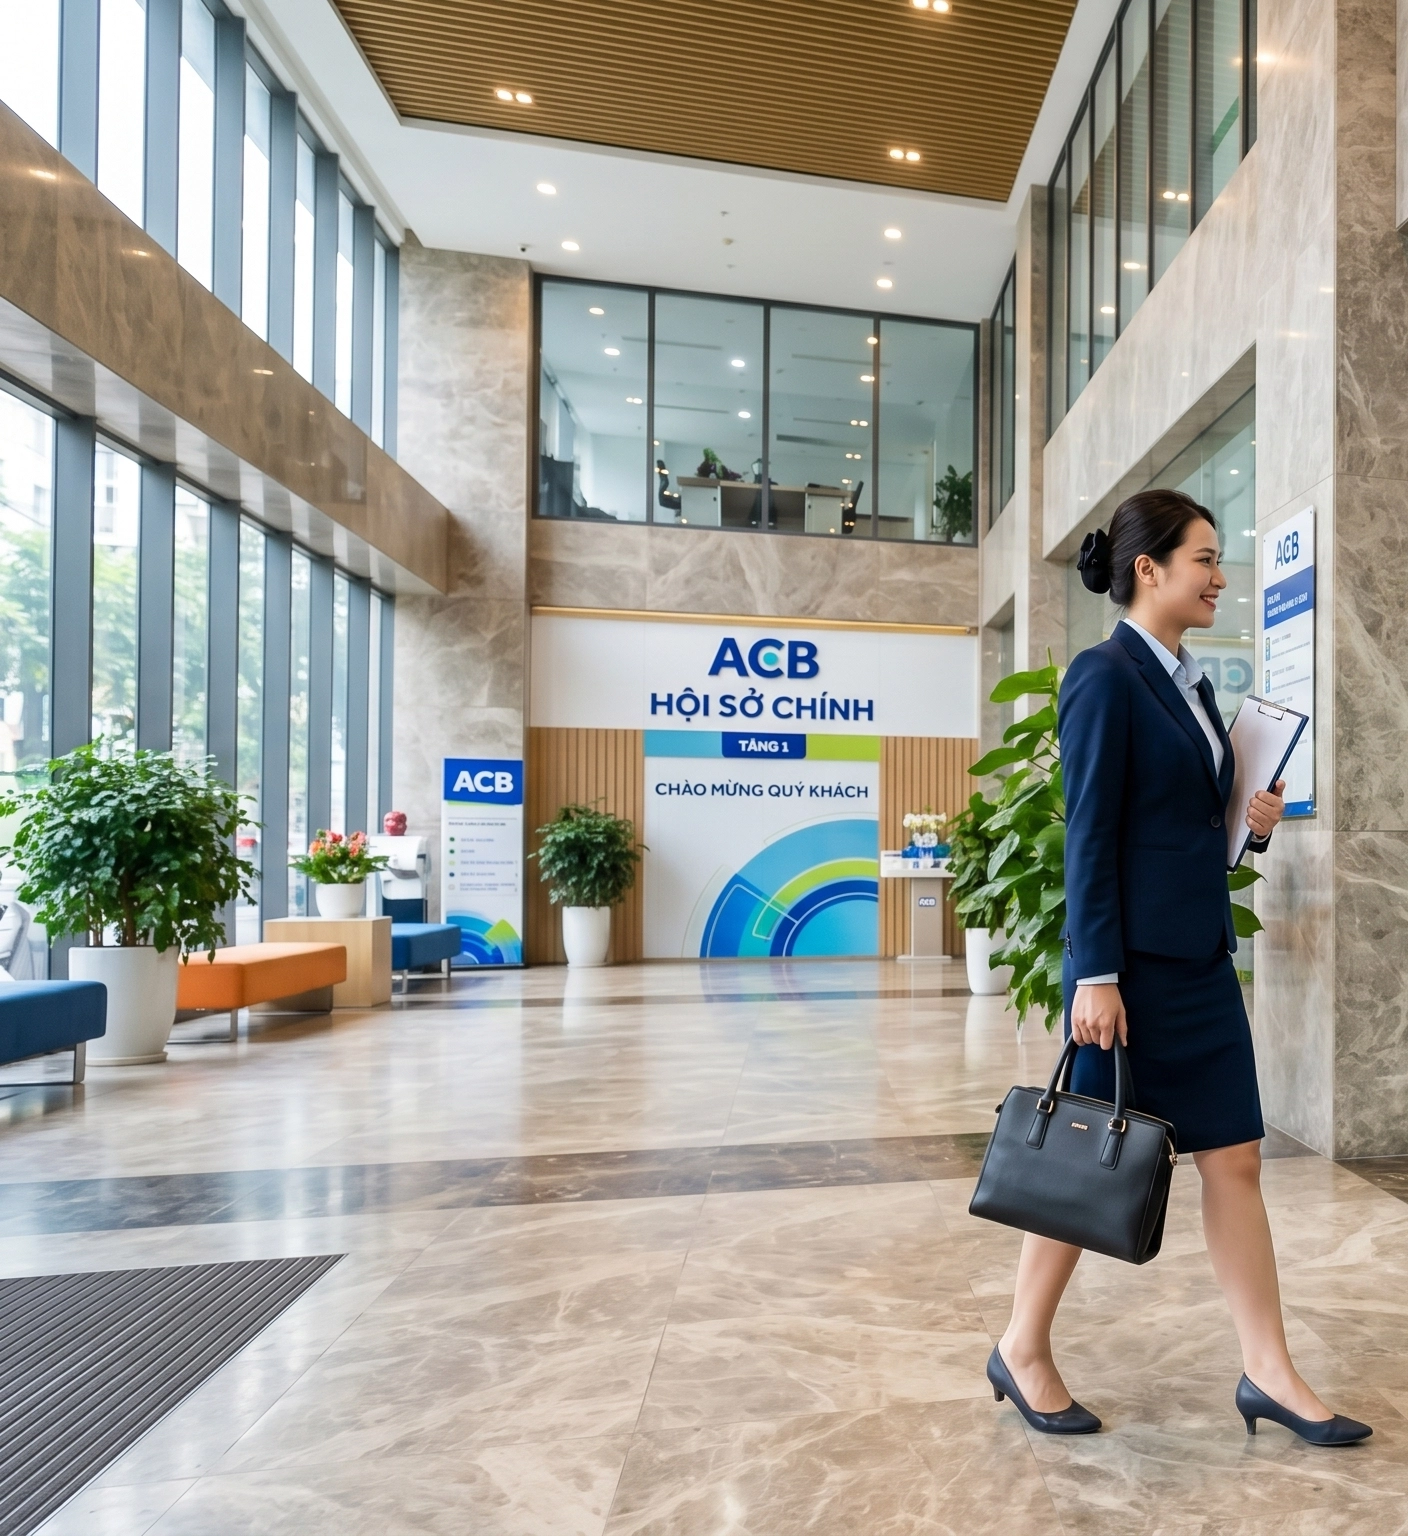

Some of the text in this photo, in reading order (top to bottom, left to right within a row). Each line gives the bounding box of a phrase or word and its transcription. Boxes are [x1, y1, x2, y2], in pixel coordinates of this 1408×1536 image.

[1274, 530, 1299, 570] ACB
[707, 637, 820, 679] ACB
[650, 686, 874, 722] HỘI SỞ CHÍNH
[781, 741, 789, 753] 1
[452, 770, 514, 793] ACB
[655, 779, 869, 798] CHÀO MỪNG QUÝ KHÁCH
